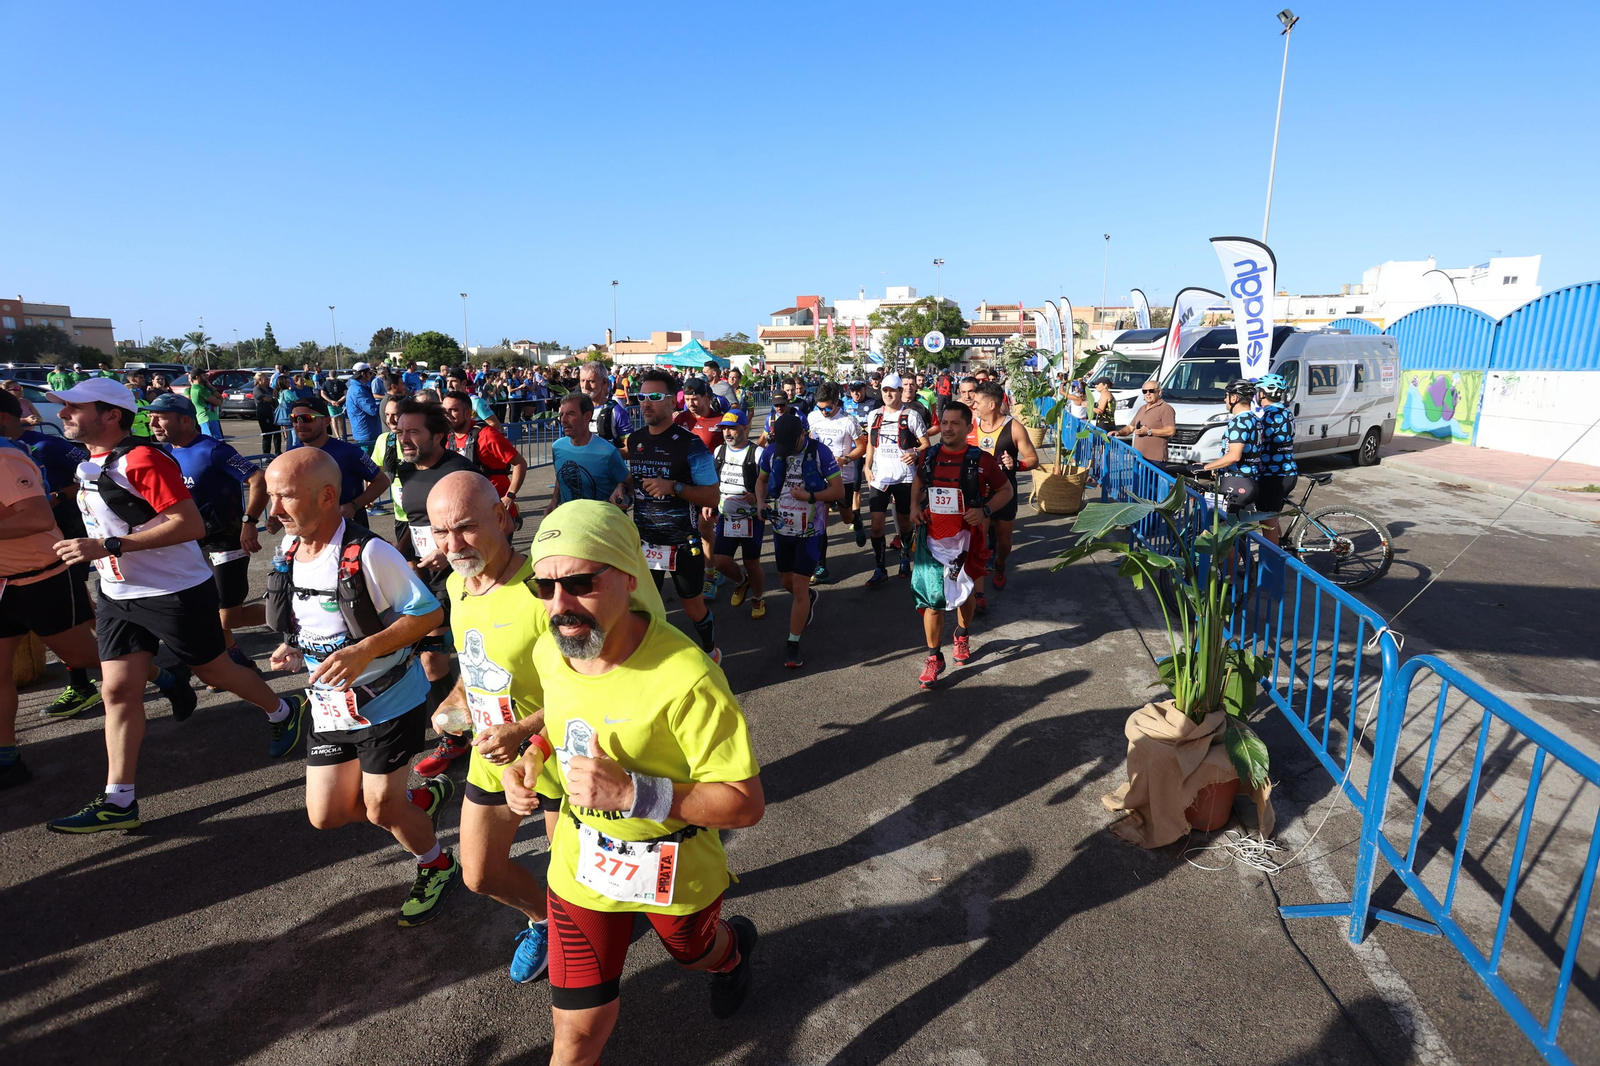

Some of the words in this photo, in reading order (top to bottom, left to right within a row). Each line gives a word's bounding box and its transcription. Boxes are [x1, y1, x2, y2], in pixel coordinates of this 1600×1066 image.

[950, 338, 972, 346] TRAIL
[974, 338, 1001, 346] PIRATA
[935, 495, 952, 505] 337
[645, 549, 663, 560] 295
[320, 703, 341, 718] 315
[594, 851, 640, 881] 277
[658, 854, 673, 894] PIRATA
